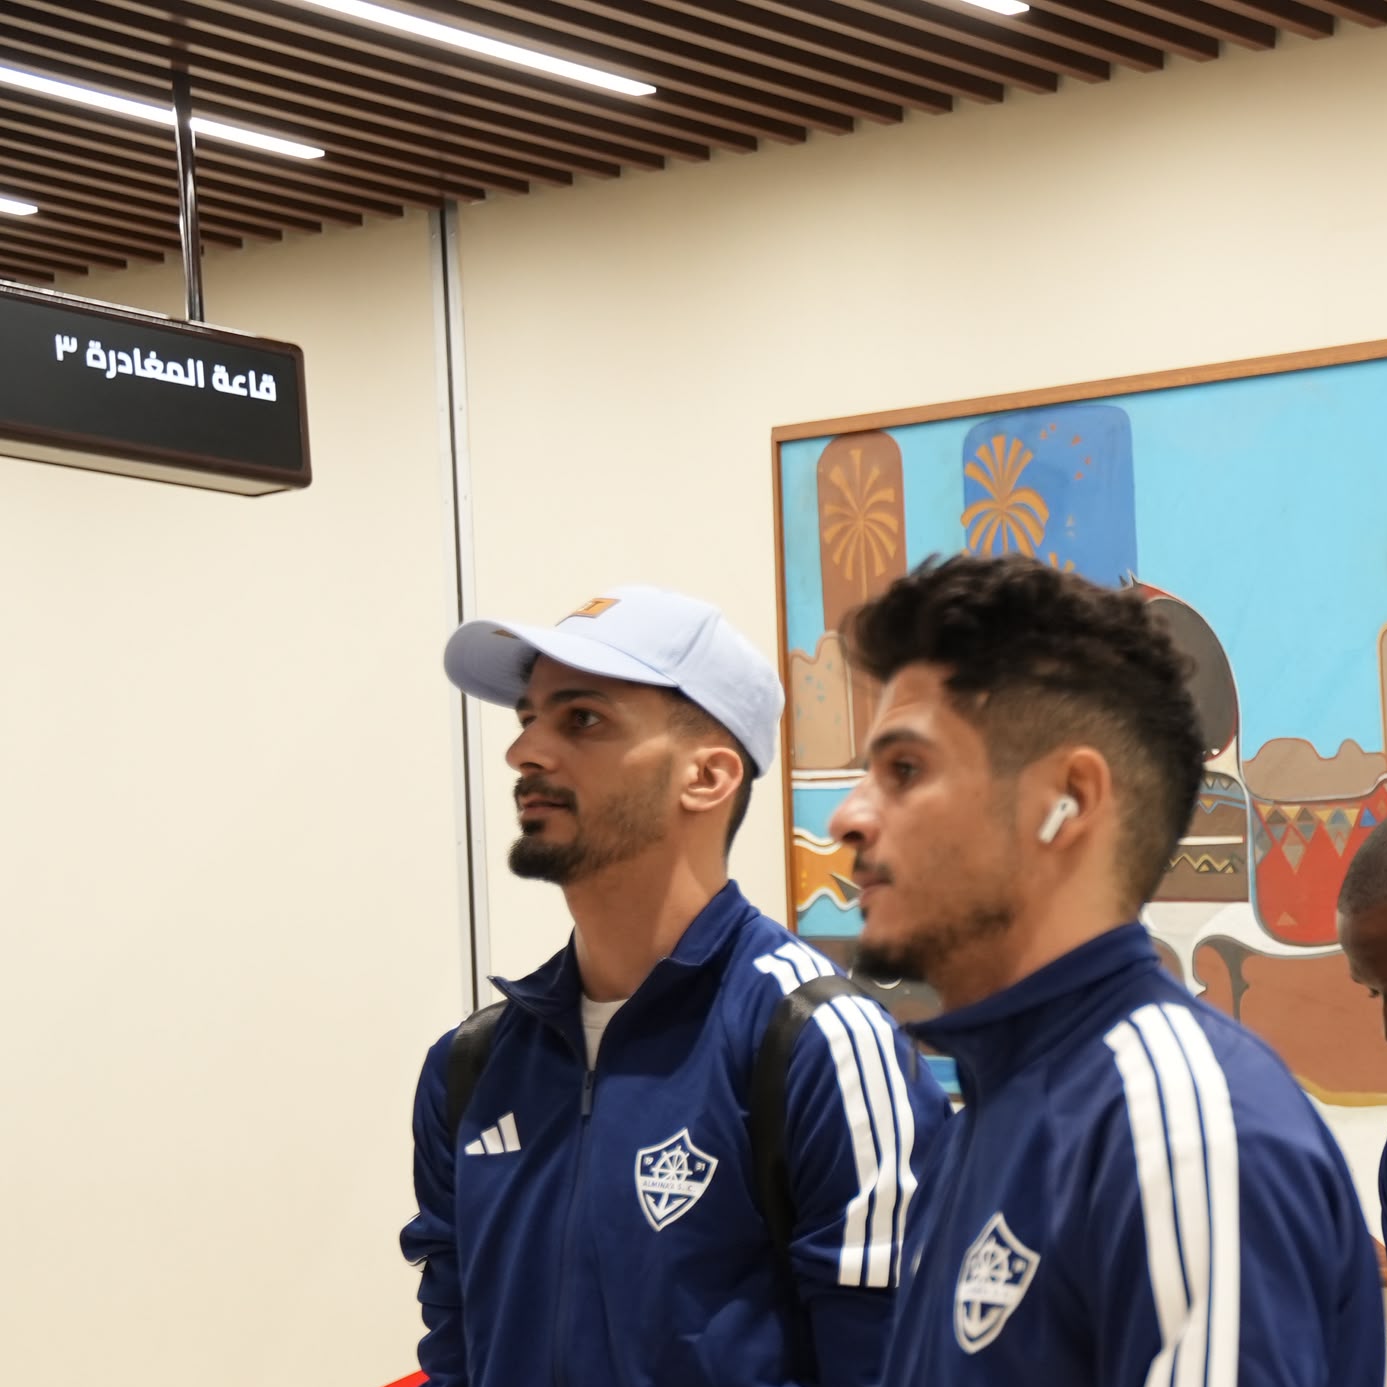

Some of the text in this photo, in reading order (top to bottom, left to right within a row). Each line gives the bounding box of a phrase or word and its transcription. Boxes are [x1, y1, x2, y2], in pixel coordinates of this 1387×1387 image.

[55, 333, 277, 402] قاعة المغادرة ٣
